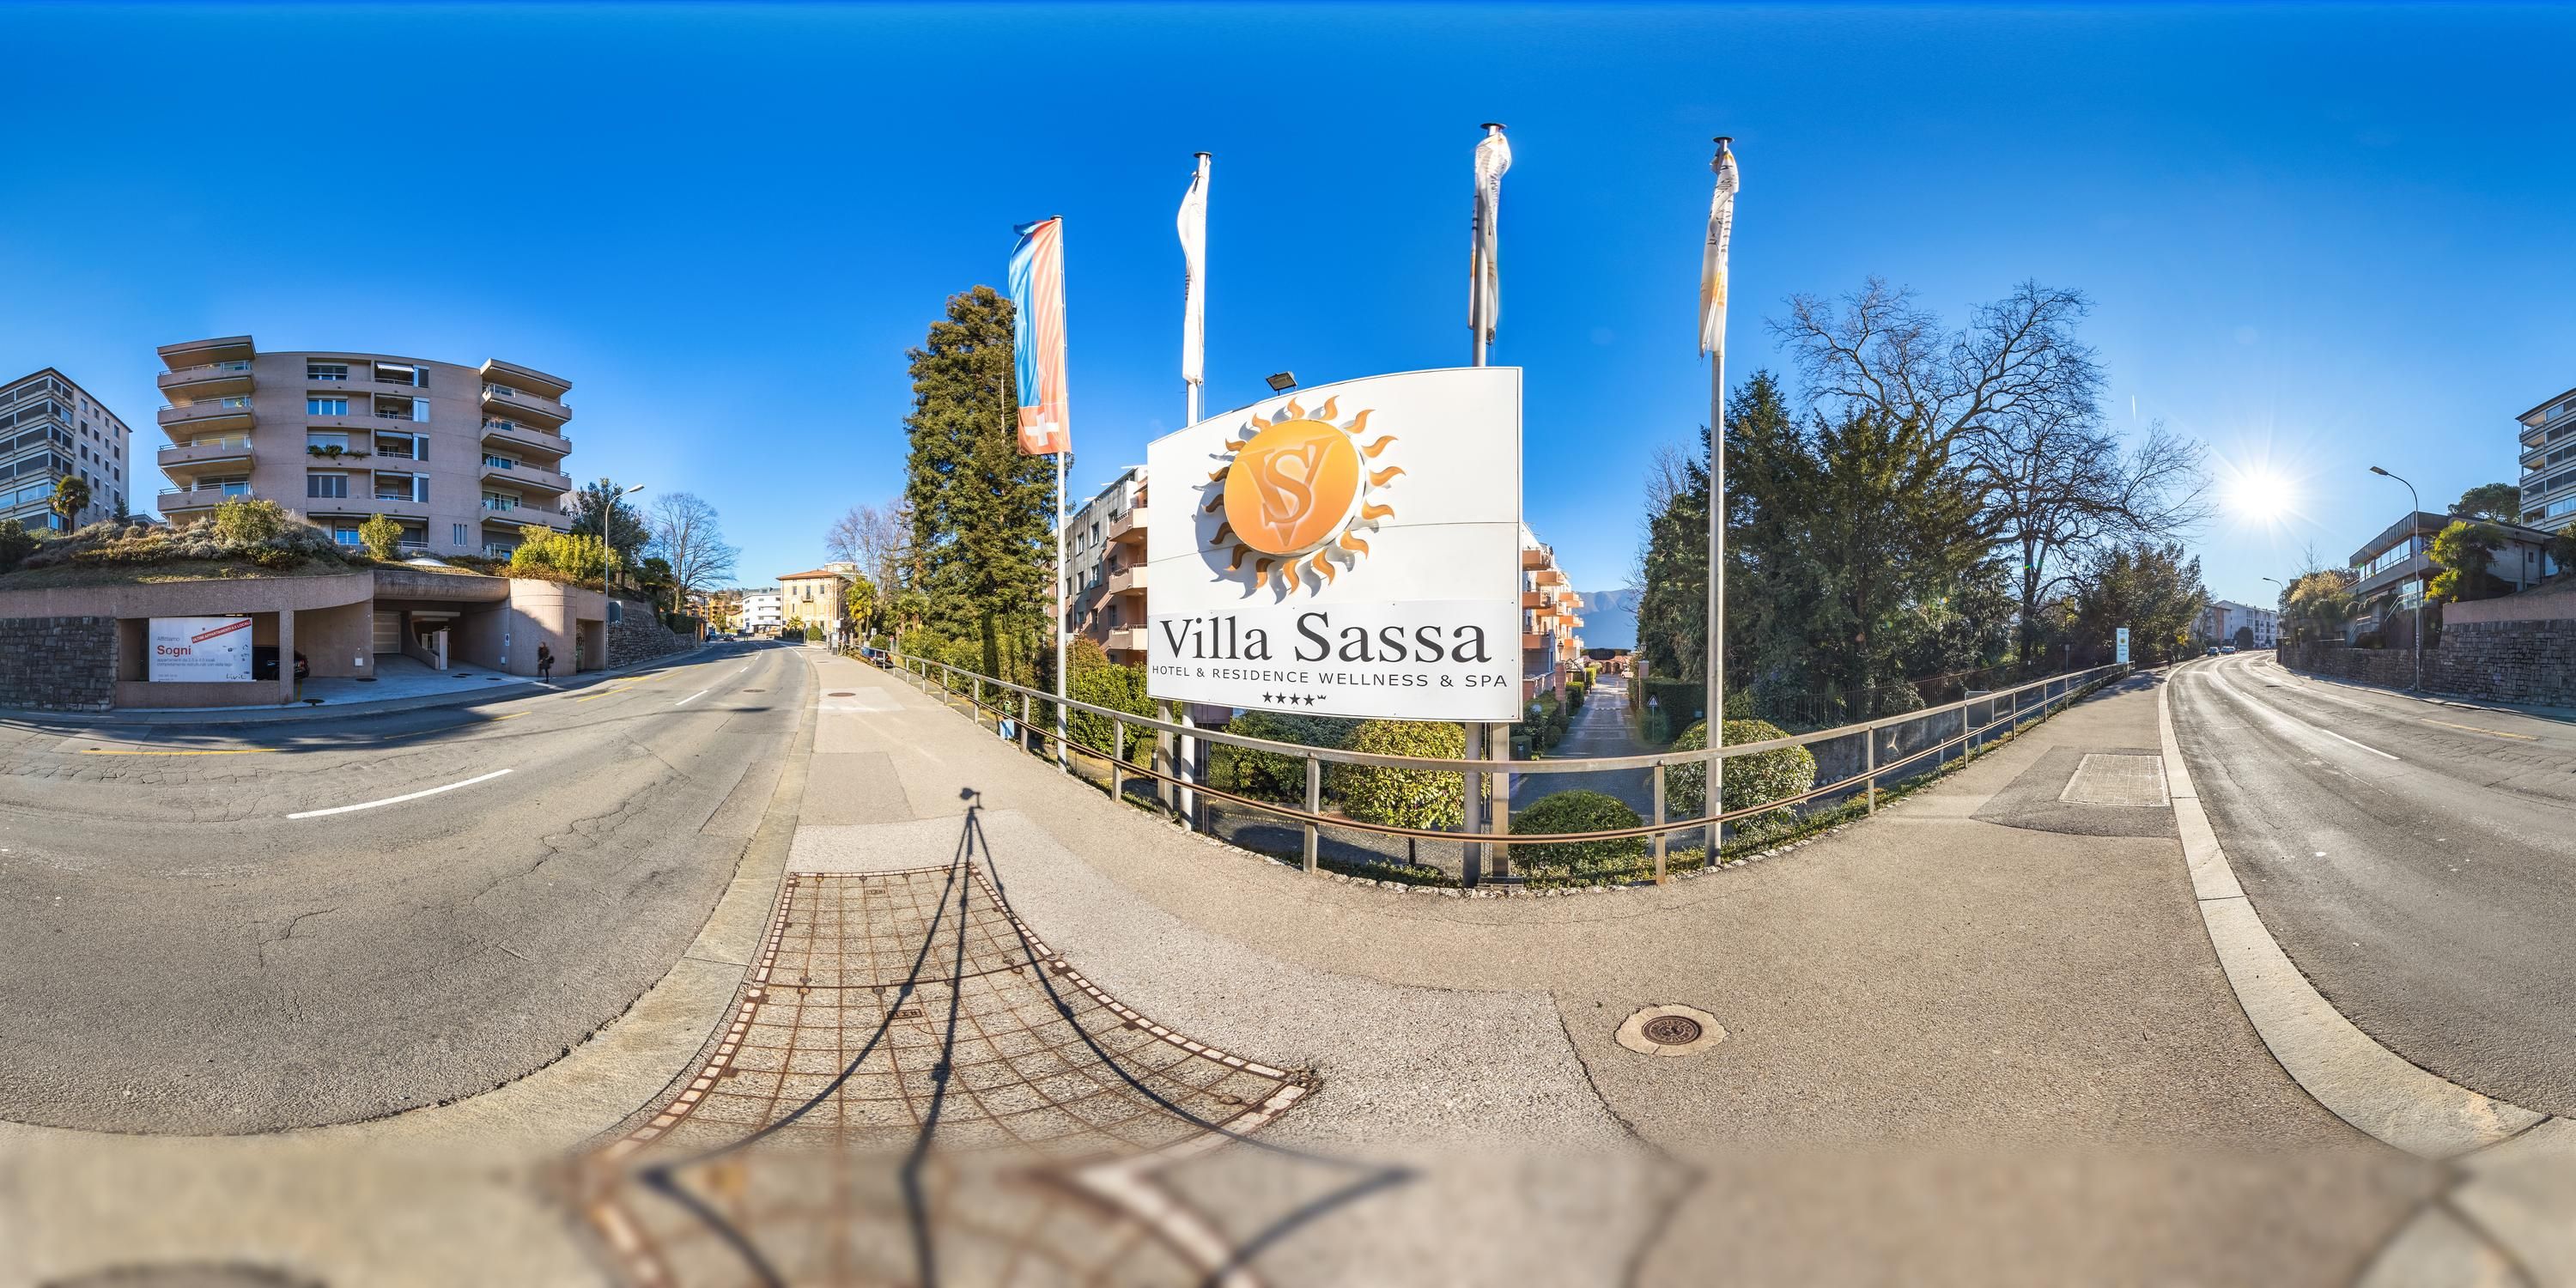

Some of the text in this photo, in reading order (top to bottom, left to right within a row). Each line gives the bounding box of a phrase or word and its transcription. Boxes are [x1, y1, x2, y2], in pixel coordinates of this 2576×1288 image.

[1159, 611, 1492, 663] Villa Sassa
[157, 645, 191, 657] Sogni
[1152, 665, 1508, 688] HOTEL & RESIDENCE WELLNESS & SPA
